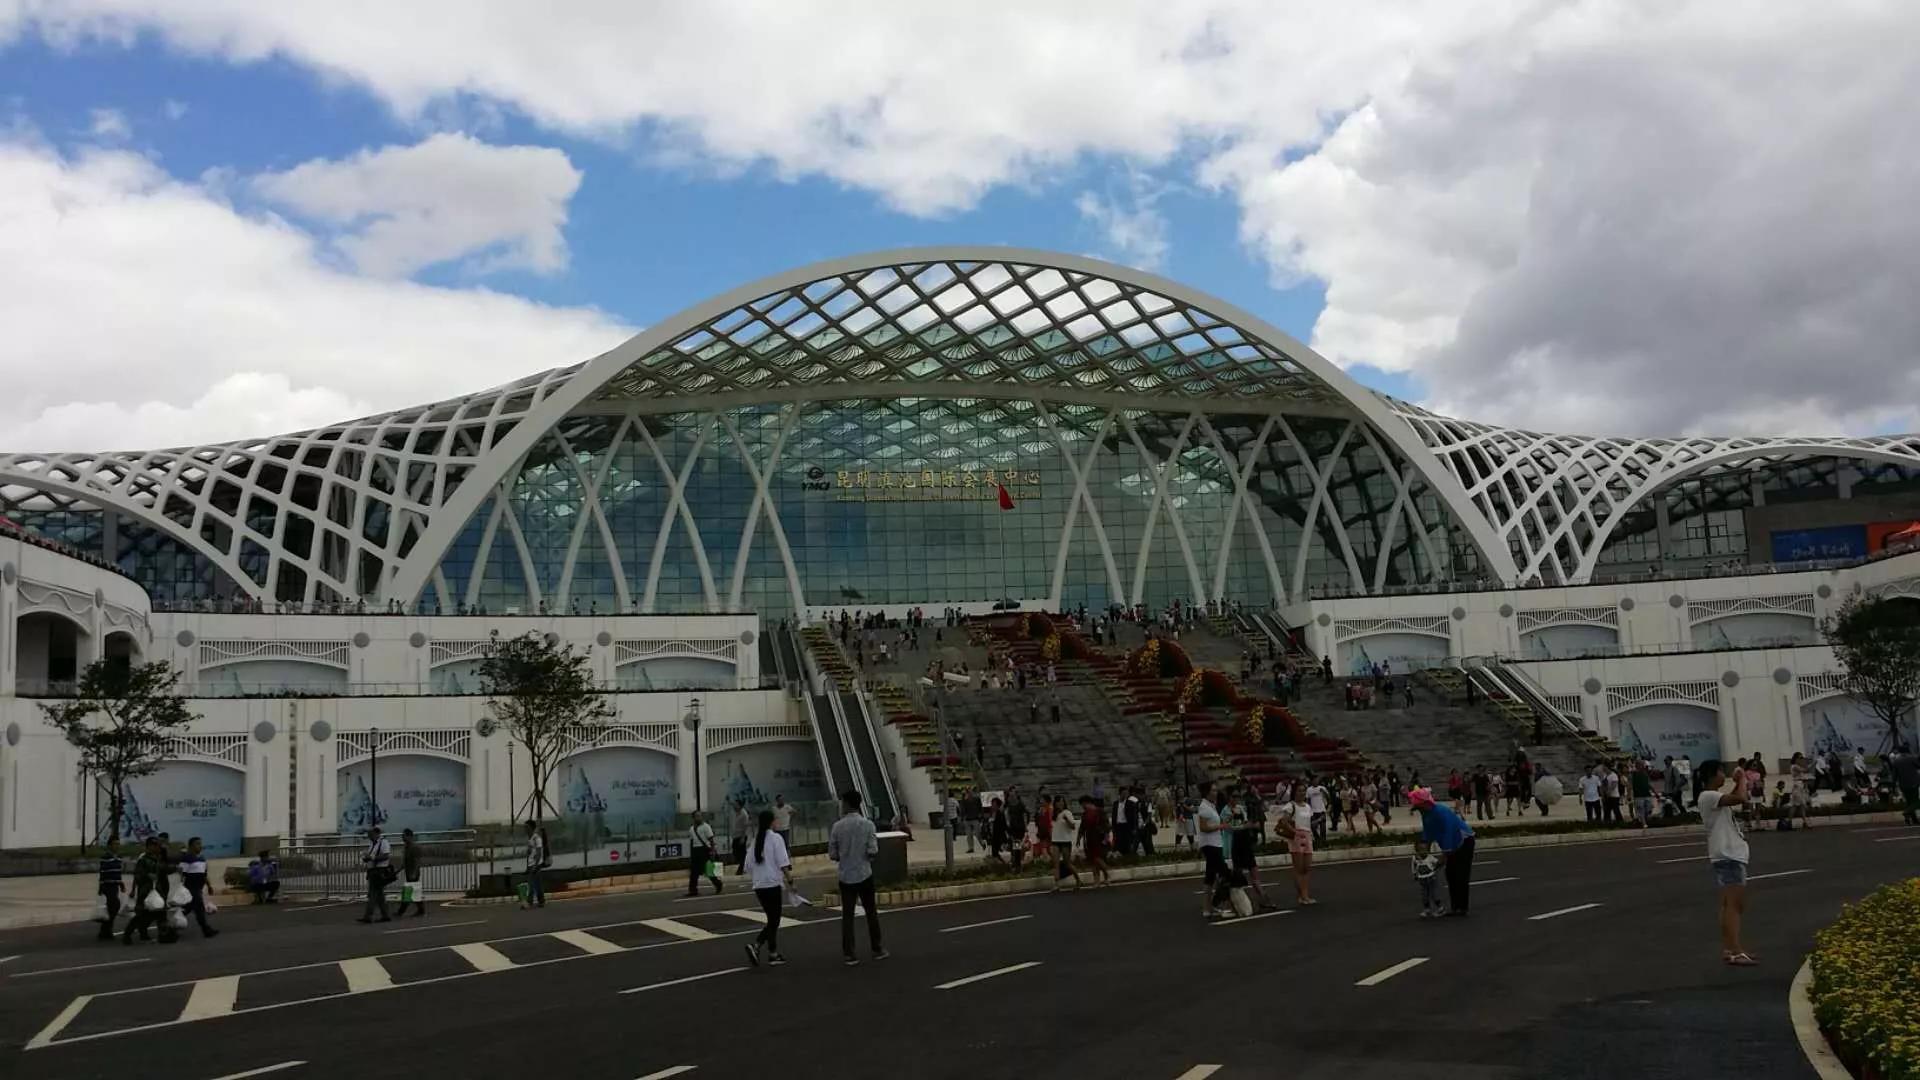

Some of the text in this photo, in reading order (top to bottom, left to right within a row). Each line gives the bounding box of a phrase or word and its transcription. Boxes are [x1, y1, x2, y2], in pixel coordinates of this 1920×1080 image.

[838, 468, 1039, 488] 昆明滇池国际会展中心
